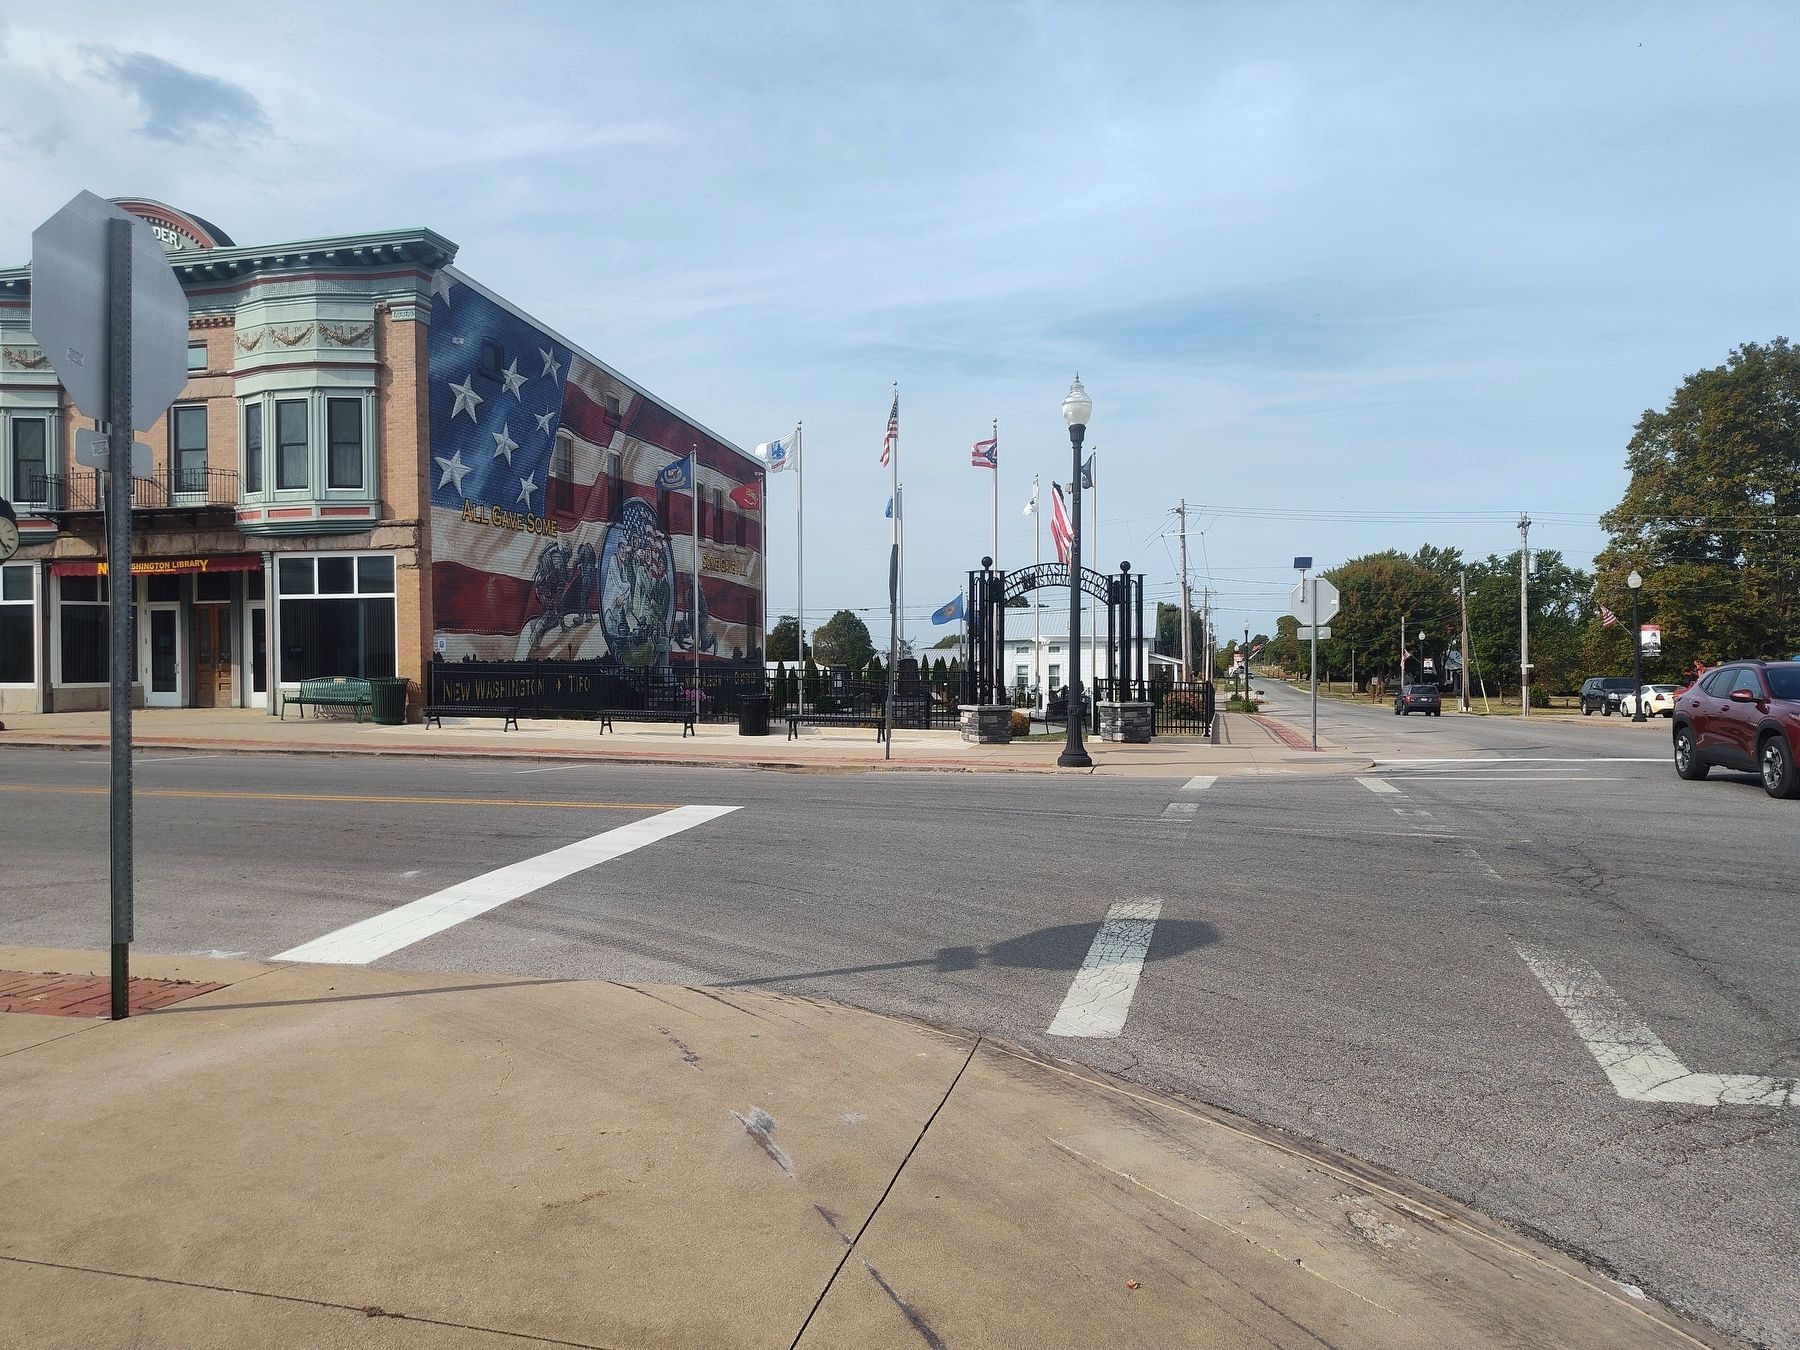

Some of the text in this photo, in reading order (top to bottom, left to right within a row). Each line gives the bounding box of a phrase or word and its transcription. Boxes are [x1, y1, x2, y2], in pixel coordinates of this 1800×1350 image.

[463, 499, 558, 537] ALL GAVE SOME
[131, 559, 209, 572] SHINGTON LIBRARY
[1004, 564, 1109, 592] NEW WASHGTON
[1047, 575, 1091, 593] MEMOAL
[443, 680, 471, 703] NEW
[474, 678, 545, 700] WASHINGTON
